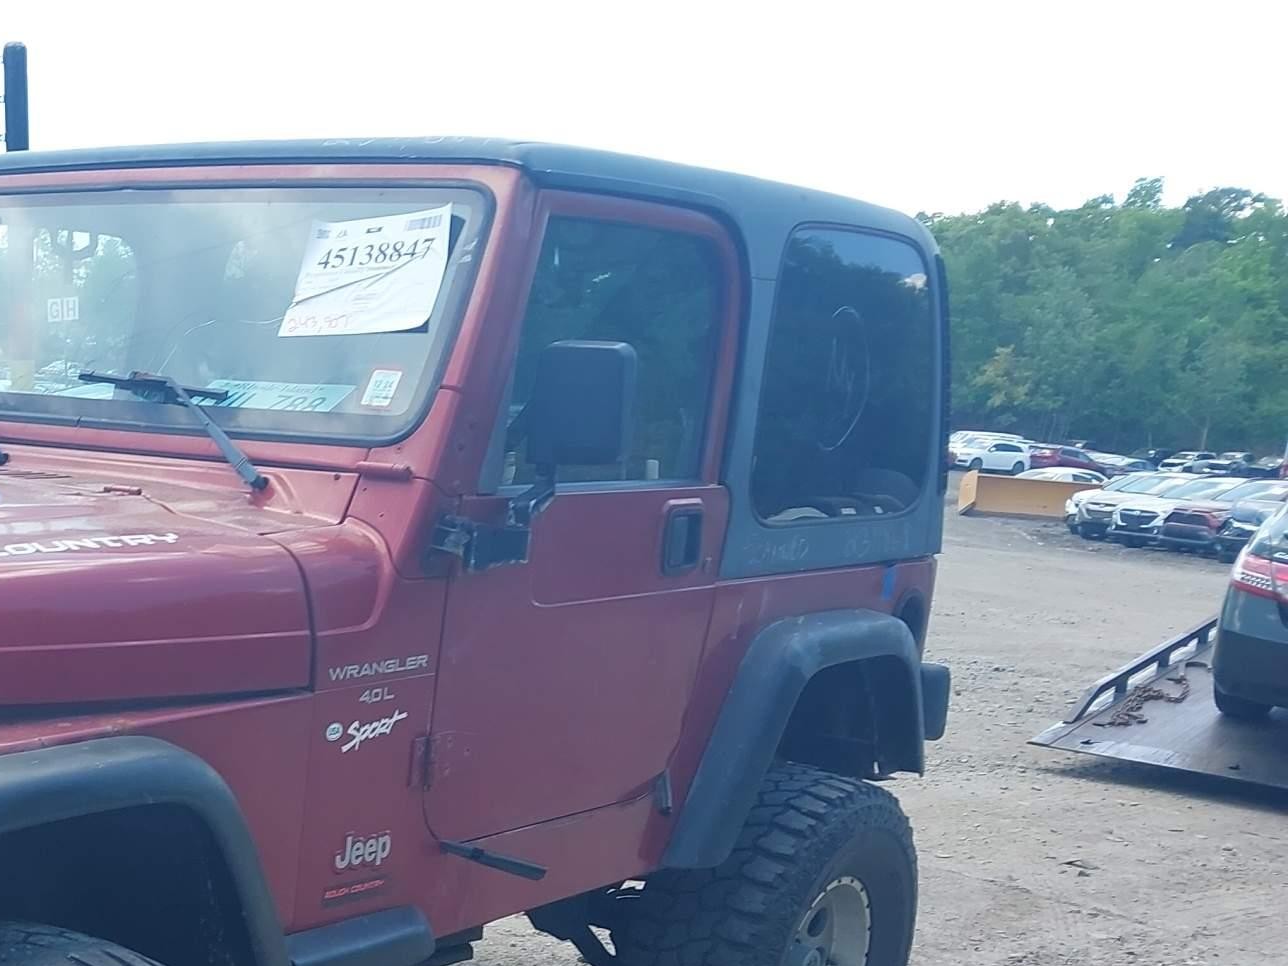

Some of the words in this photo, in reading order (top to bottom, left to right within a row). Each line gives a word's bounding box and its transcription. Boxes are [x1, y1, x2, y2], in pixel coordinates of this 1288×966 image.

[317, 237, 436, 270] 45138847
[329, 654, 429, 681] WRANGLER
[341, 709, 409, 753] Sport
[335, 833, 392, 869] Jeep
